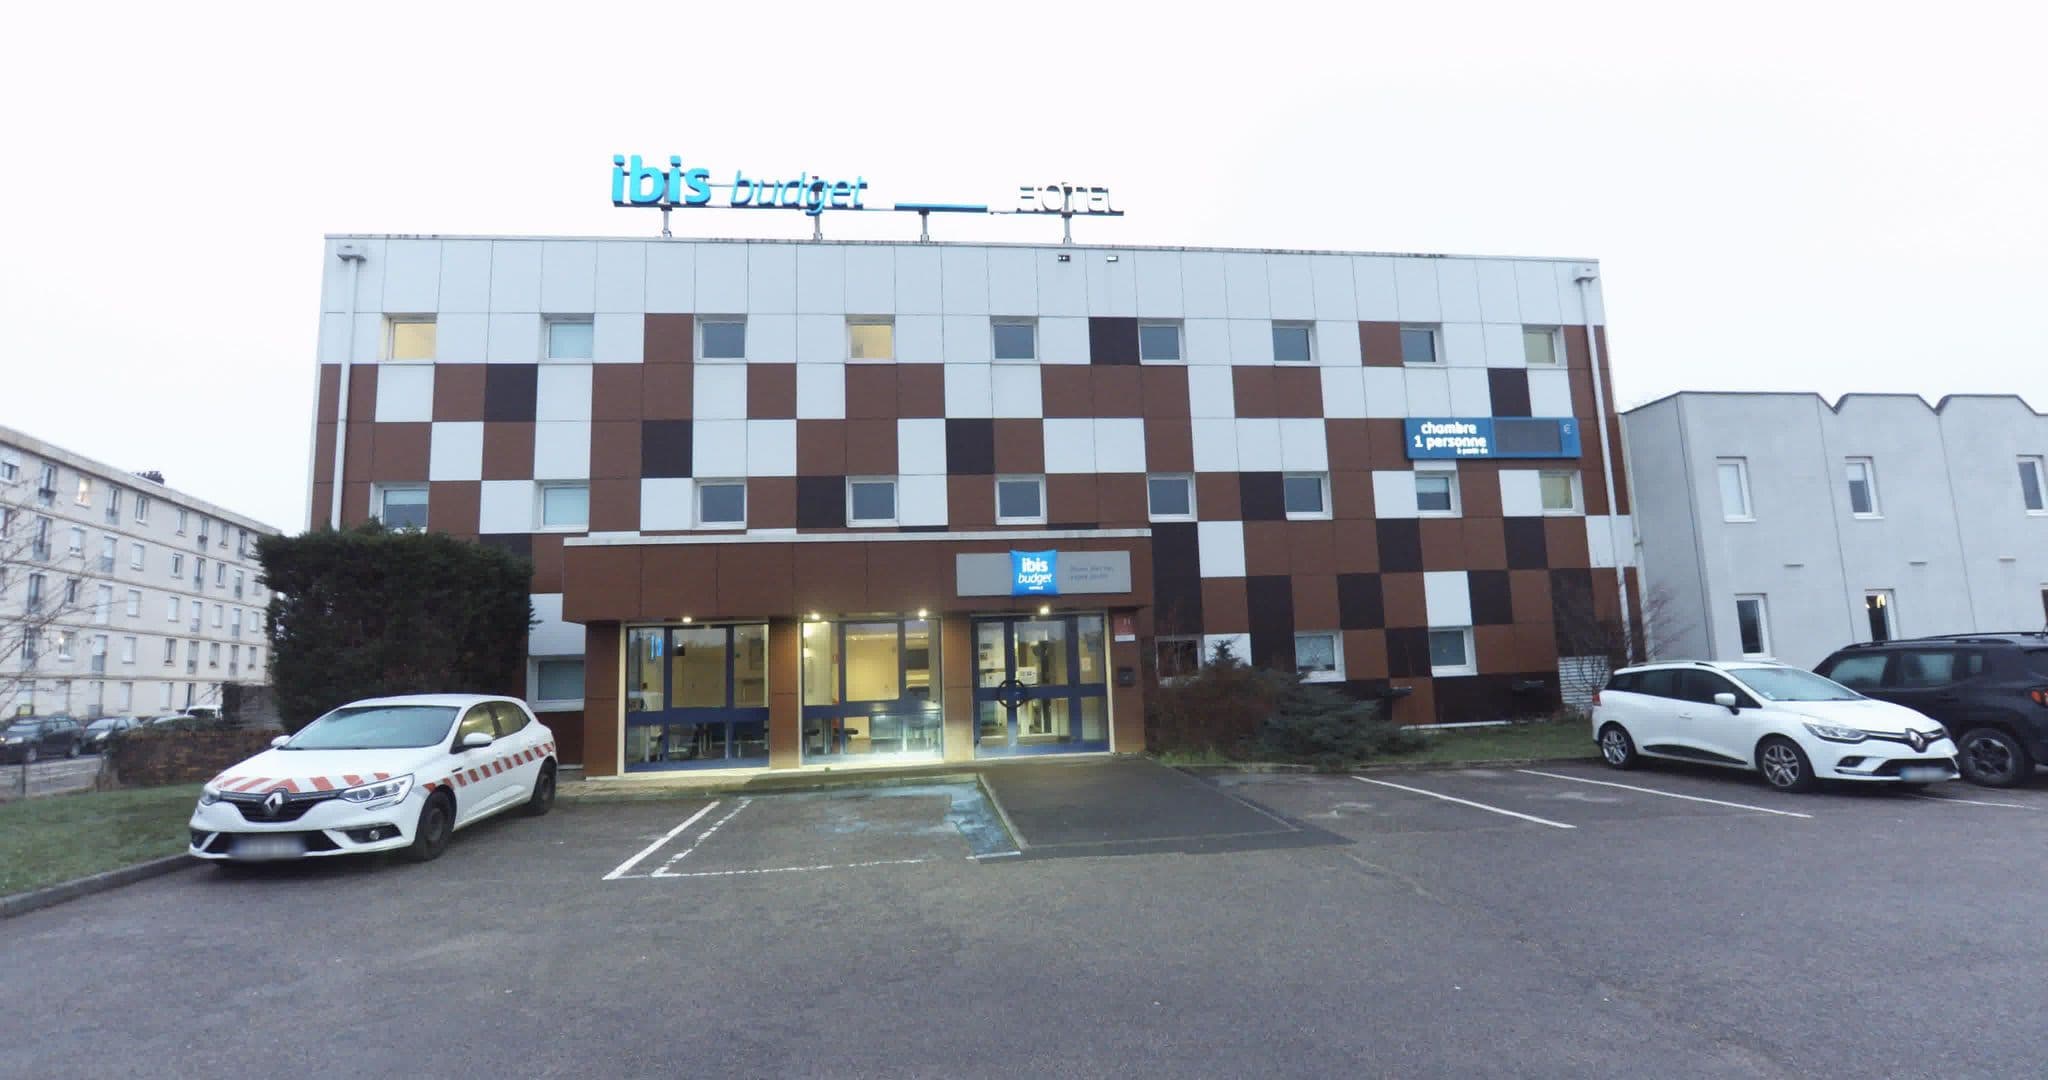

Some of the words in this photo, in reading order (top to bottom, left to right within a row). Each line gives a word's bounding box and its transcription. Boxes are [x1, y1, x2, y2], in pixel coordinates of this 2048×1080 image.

[612, 154, 711, 206] ibis
[731, 169, 867, 216] budget
[1421, 421, 1477, 435] chambre
[1414, 435, 1424, 448] 1
[1426, 436, 1487, 450] personne
[1021, 557, 1049, 572] ibis
[1018, 572, 1052, 585] budget
